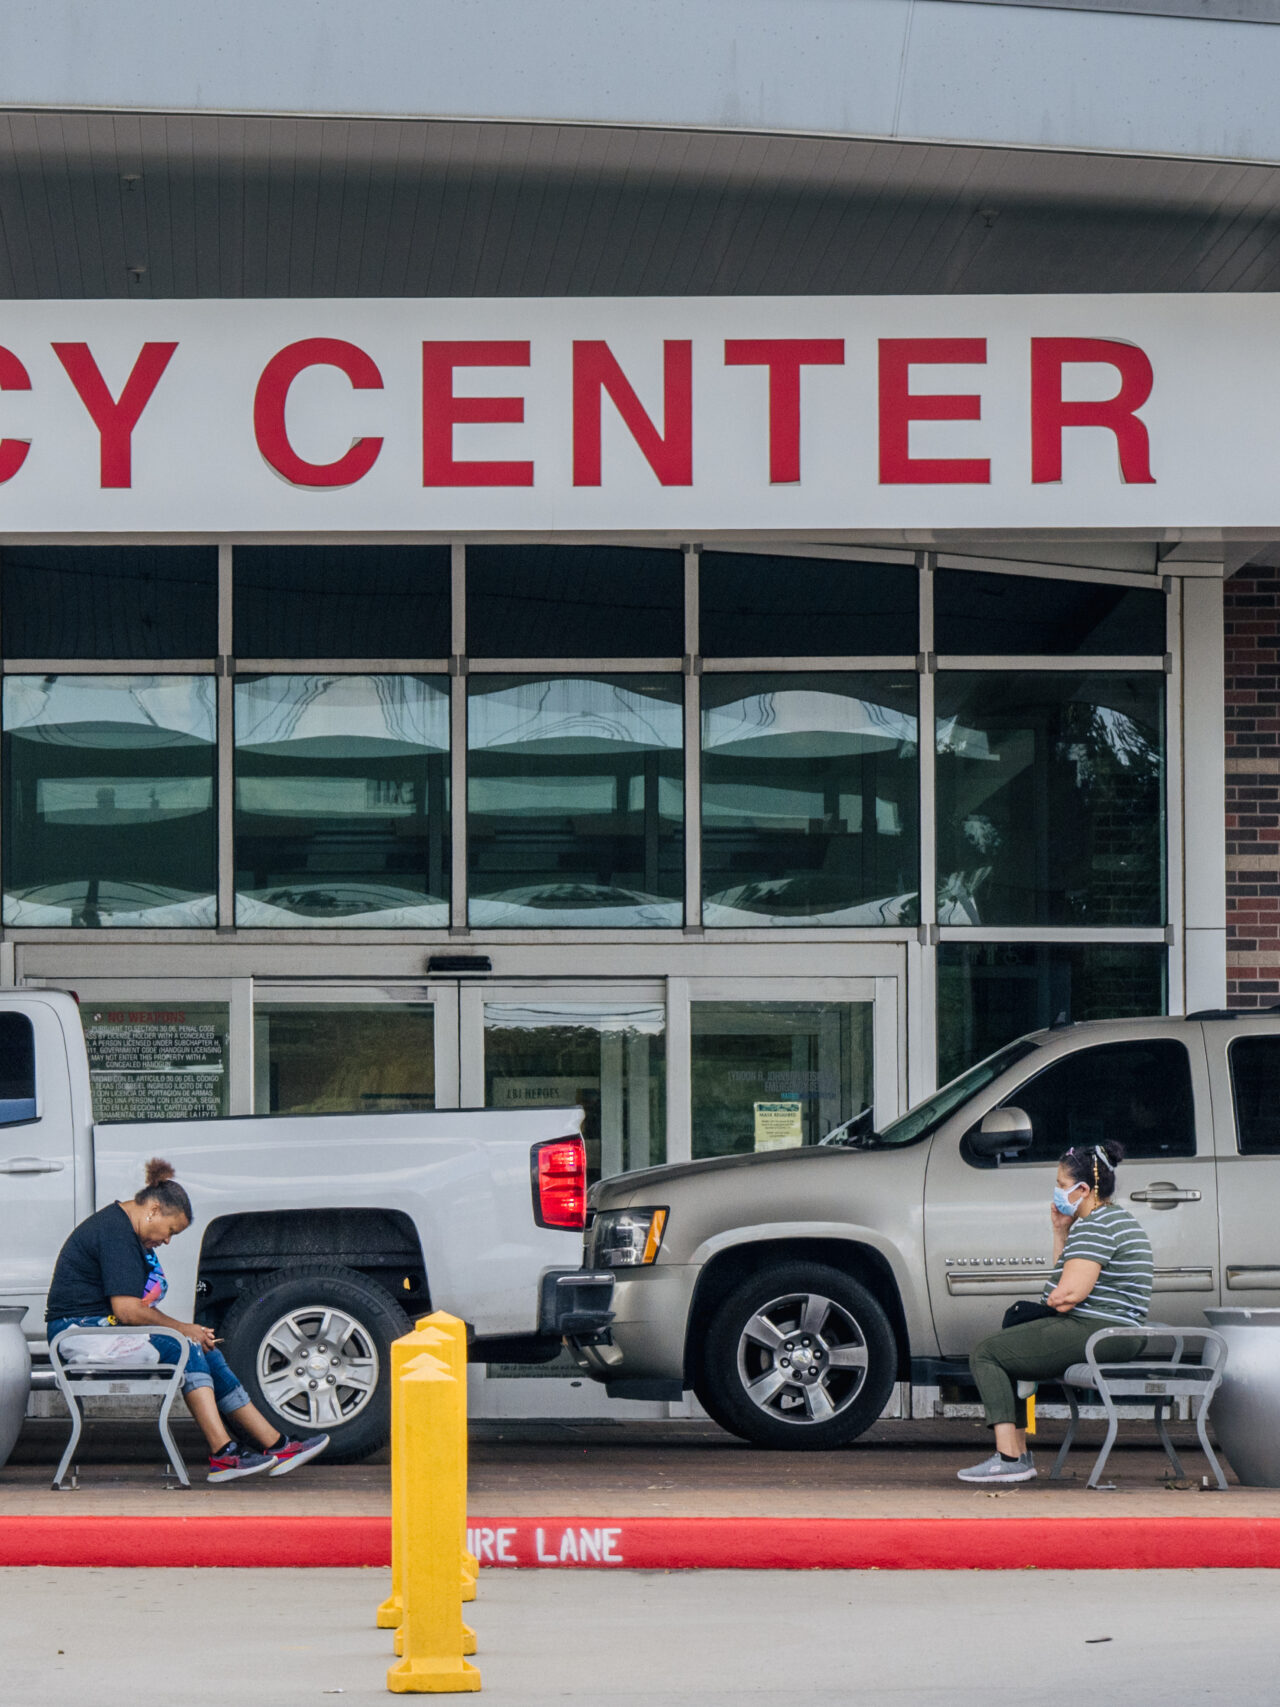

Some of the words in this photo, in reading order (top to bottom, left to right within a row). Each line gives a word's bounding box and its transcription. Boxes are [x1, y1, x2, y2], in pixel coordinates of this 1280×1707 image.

[253, 336, 1156, 492] CENTER
[108, 1012, 124, 1024] NO
[129, 1012, 186, 1024] WEAPONS
[525, 1088, 560, 1099] HEROES
[945, 1257, 1046, 1267] SUBURBAN
[467, 1528, 517, 1561] IRE
[536, 1528, 623, 1561] LANE
